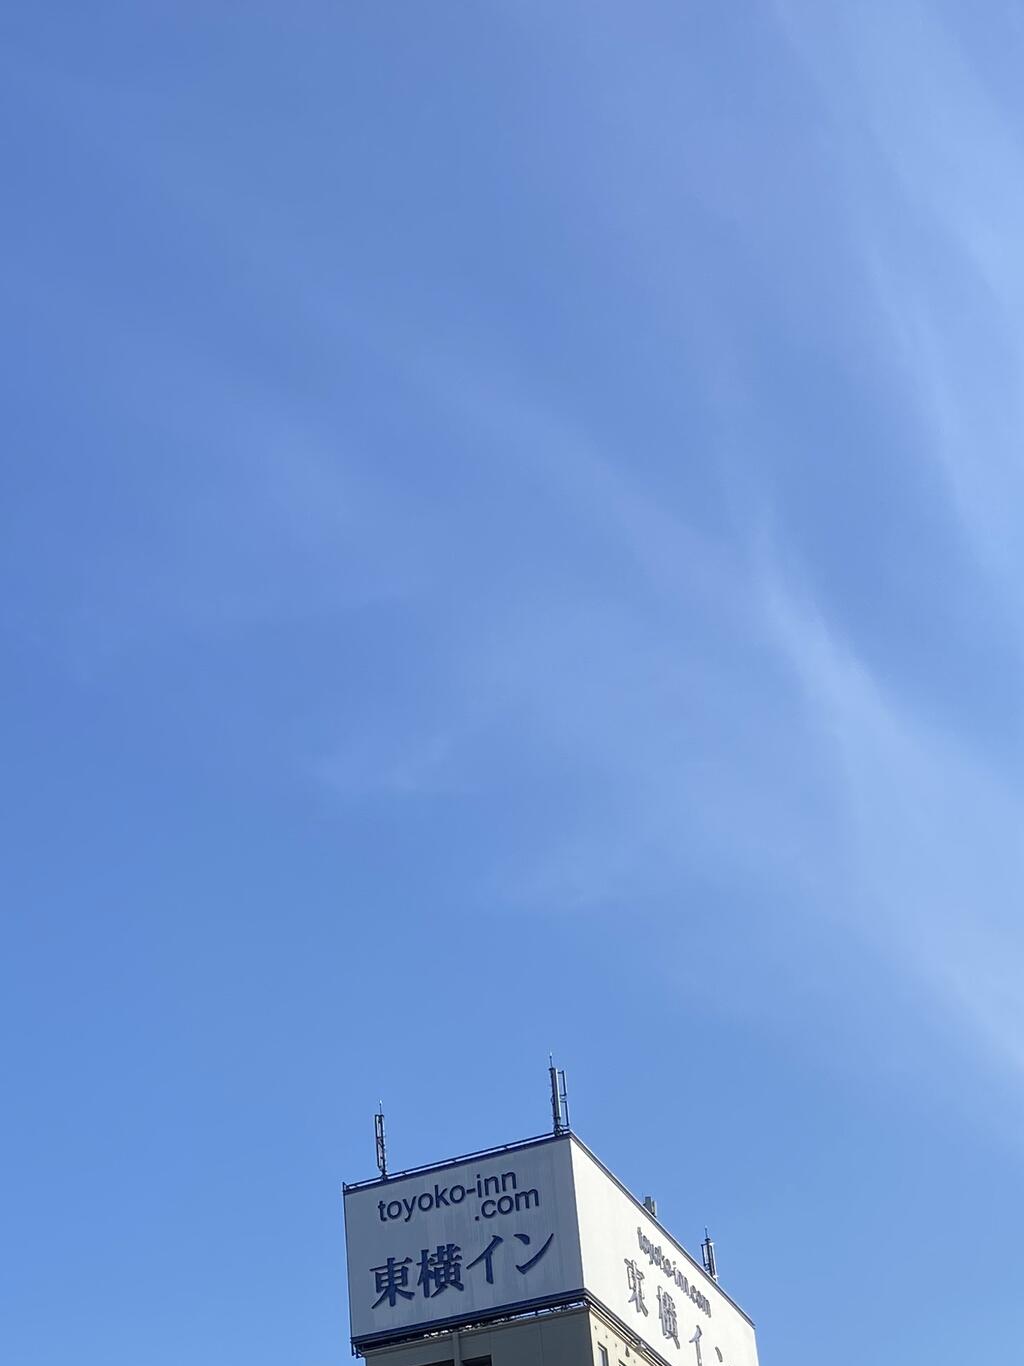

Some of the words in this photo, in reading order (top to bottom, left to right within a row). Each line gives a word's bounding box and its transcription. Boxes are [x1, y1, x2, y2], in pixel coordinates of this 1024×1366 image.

[377, 1171, 518, 1223] toyoko-inn
[474, 1188, 540, 1222] .com
[369, 1232, 555, 1310] 東横イン
